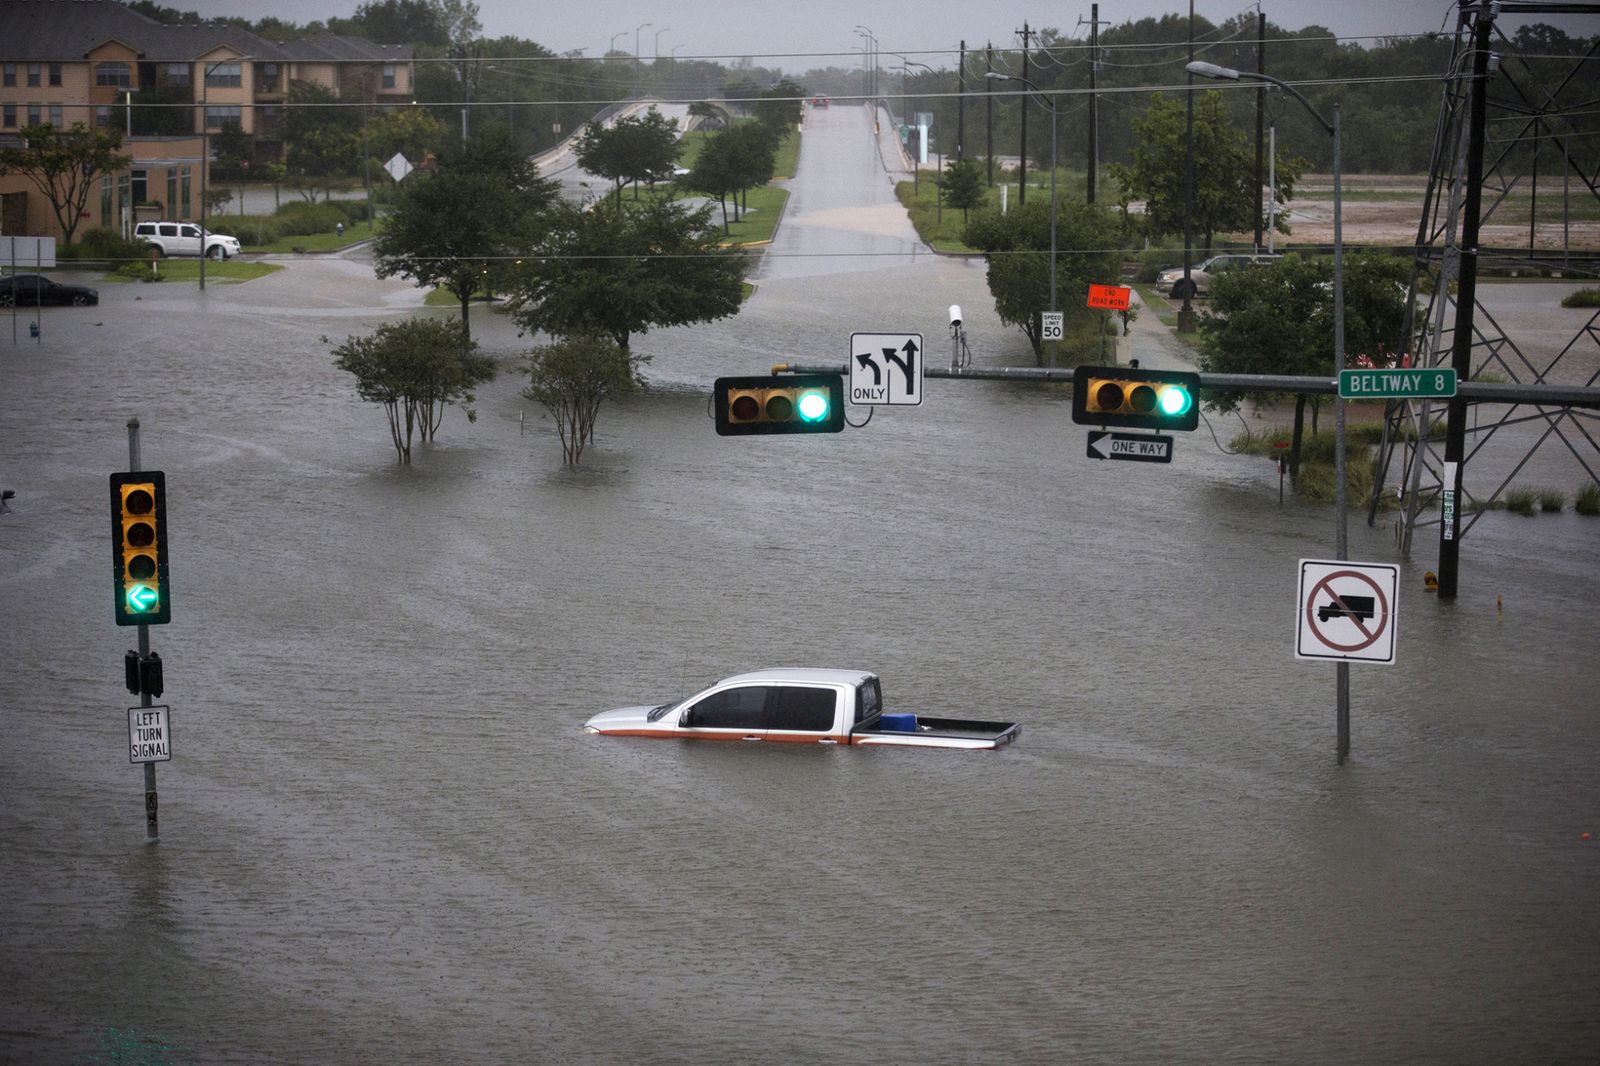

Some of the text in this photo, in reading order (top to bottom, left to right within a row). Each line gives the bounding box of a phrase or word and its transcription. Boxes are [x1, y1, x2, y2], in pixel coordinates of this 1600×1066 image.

[1104, 288, 1116, 296] END
[1092, 296, 1125, 306] ROAD WORK
[1044, 326, 1061, 337] 50
[1350, 374, 1445, 392] BELTWAY 8
[853, 387, 886, 399] ONLY
[1112, 441, 1164, 455] ONE WAY
[136, 712, 160, 726] LEFT
[137, 727, 162, 741] TURN
[132, 743, 168, 757] SIGNAL
